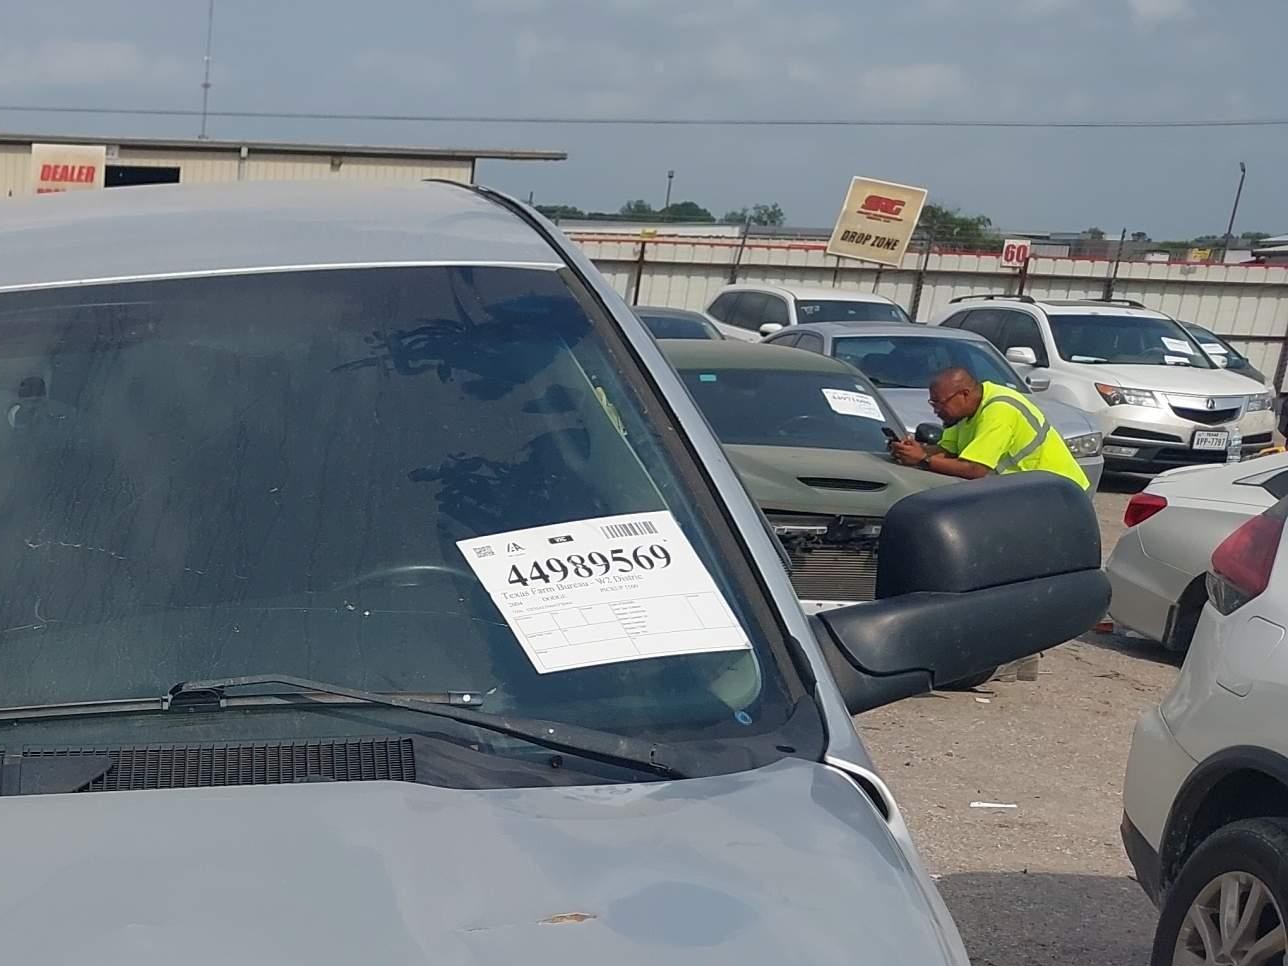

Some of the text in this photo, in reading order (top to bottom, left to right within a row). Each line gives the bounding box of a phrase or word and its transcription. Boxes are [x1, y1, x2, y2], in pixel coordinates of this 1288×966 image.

[40, 164, 95, 184] DEALER
[840, 230, 900, 250] DROP ZONE
[1004, 244, 1027, 262] 60
[508, 544, 671, 586] 44989569
[501, 590, 530, 600] Texas
[531, 586, 556, 595] Farm
[556, 581, 589, 591] Bureau
[595, 576, 612, 585] W2
